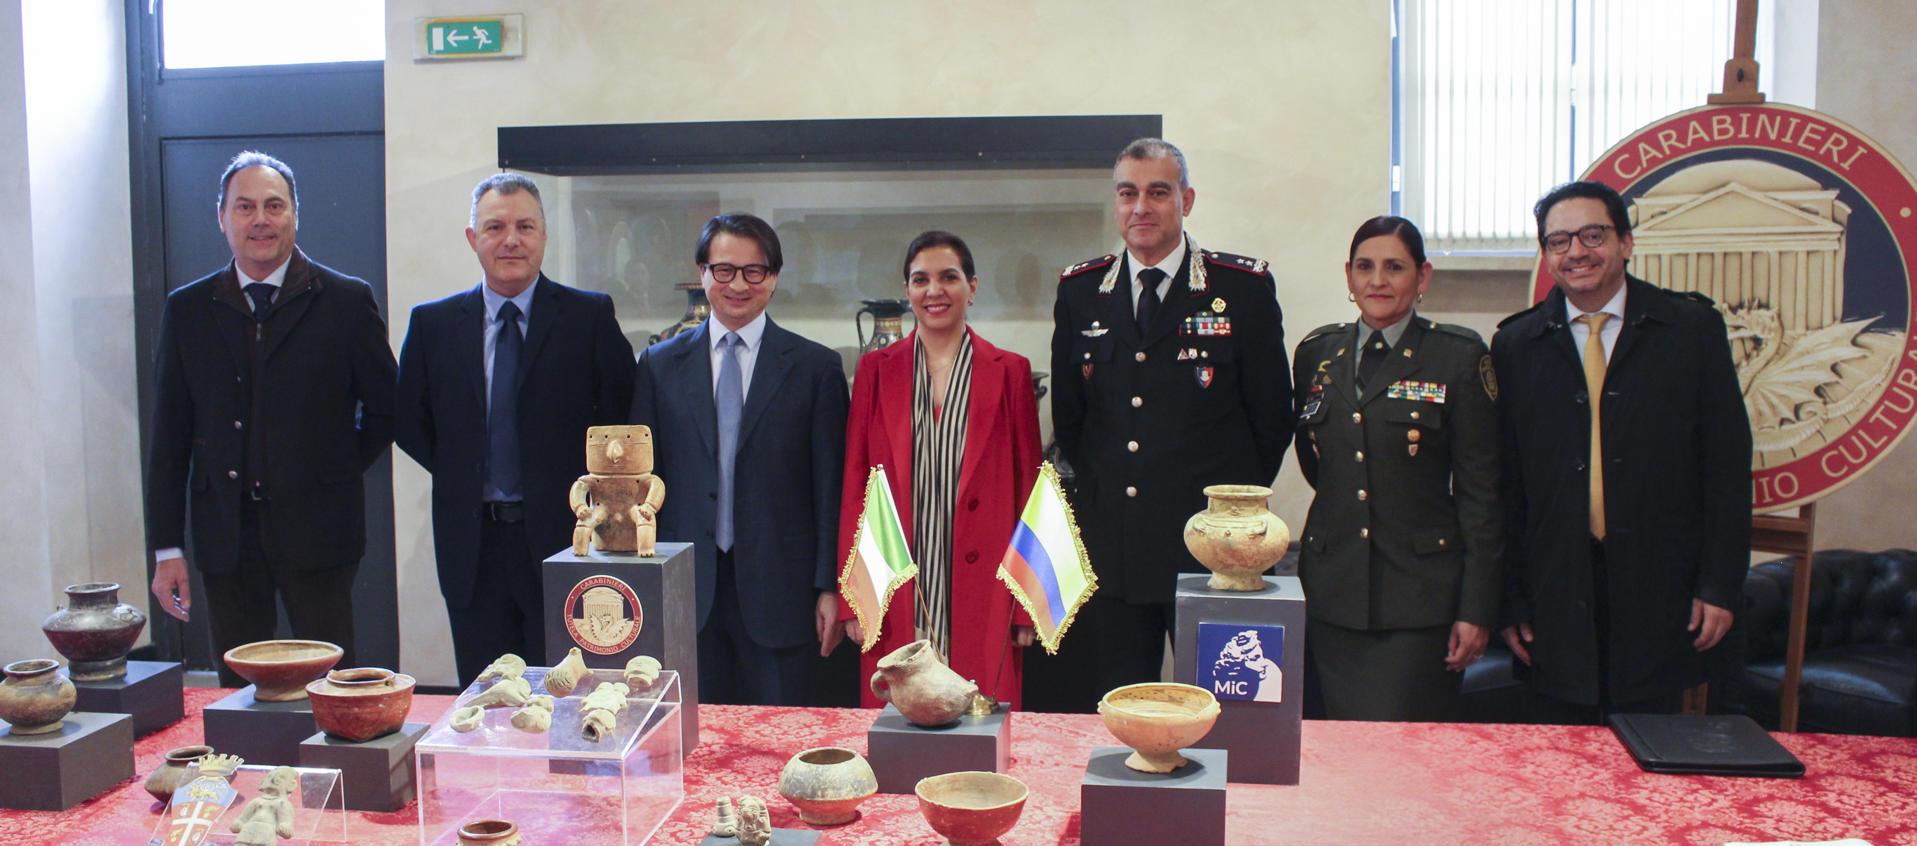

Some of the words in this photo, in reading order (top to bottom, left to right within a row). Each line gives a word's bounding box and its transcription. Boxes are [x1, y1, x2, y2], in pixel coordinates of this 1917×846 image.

[1613, 113, 1868, 179] CARABINIERI
[580, 577, 626, 591] CARABINIERI
[567, 614, 579, 638] TUTELA
[580, 639, 619, 653] PATRIMONIO
[620, 616, 640, 648] CULTURALE
[1214, 680, 1248, 695] MiC
